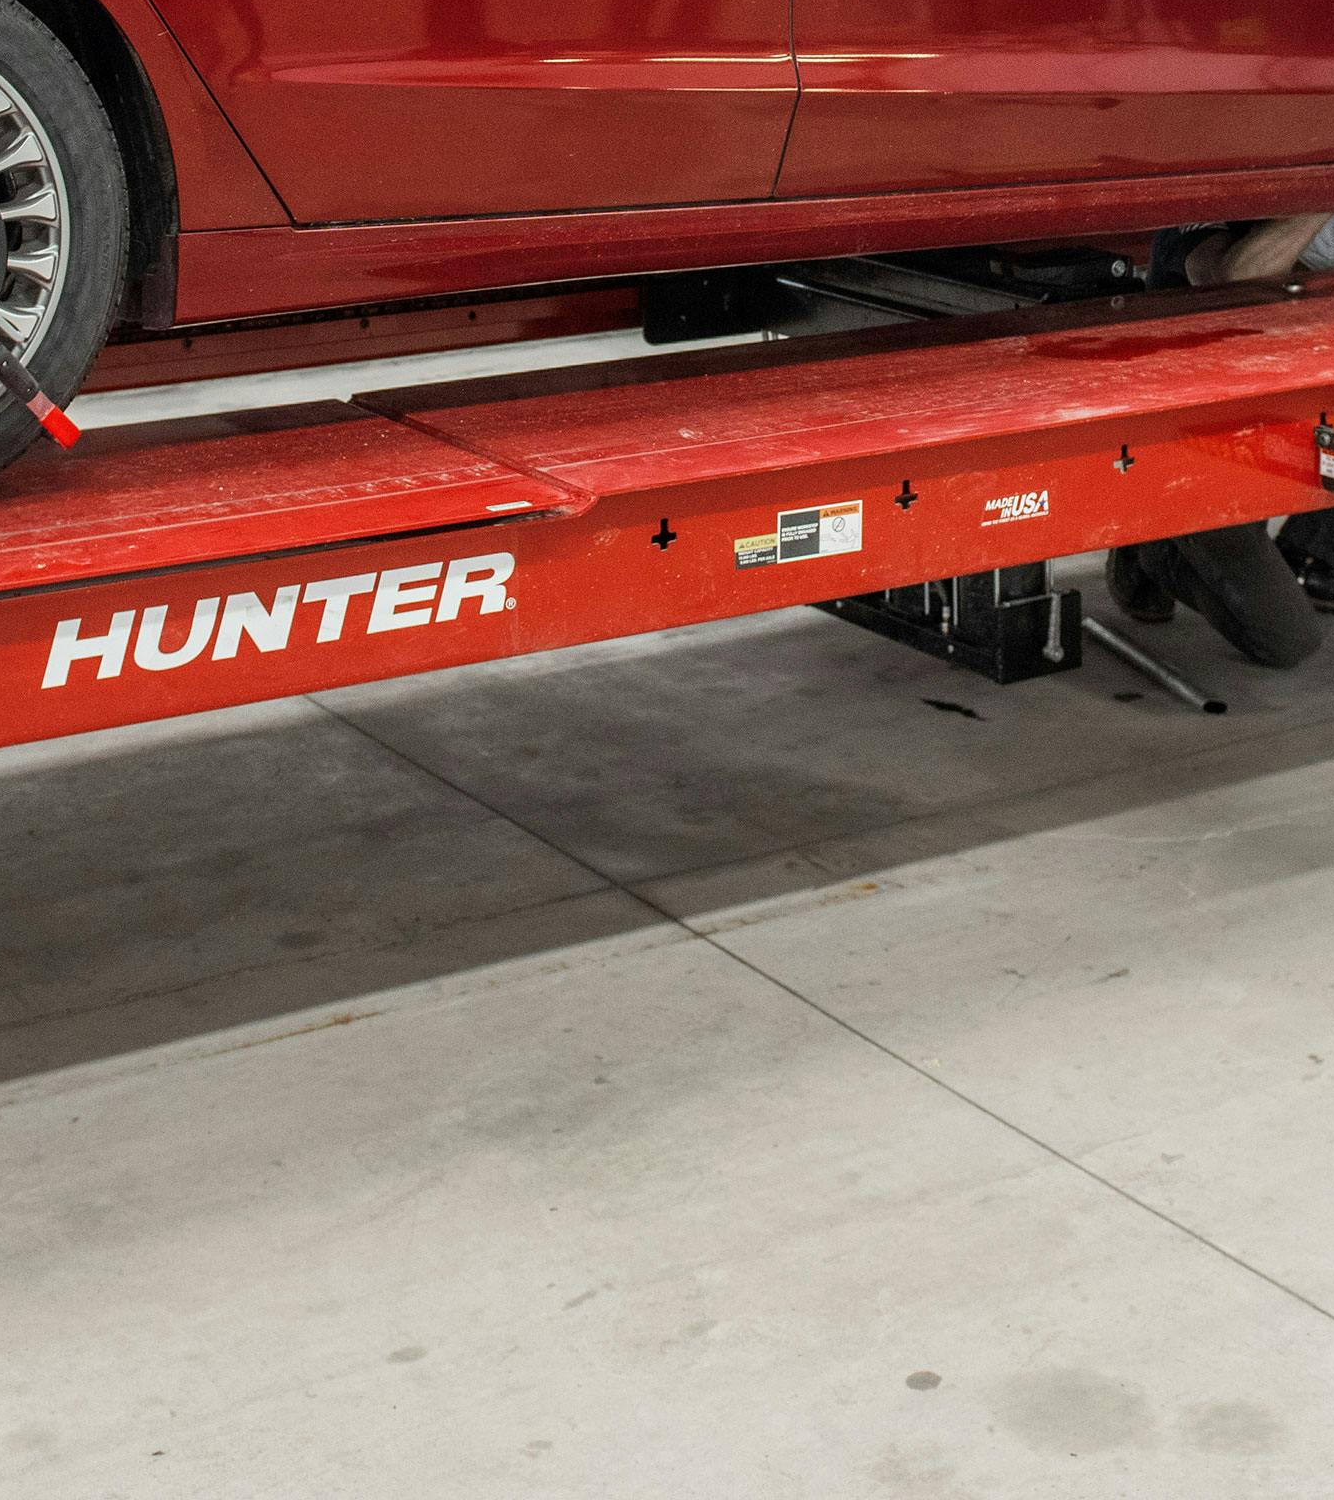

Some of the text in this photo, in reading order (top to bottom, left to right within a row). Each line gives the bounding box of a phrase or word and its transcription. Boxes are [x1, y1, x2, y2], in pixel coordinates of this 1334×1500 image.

[985, 496, 1014, 511] MADE
[1012, 490, 1049, 517] USA
[1000, 507, 1012, 518] IN
[745, 538, 776, 548] CAUTION
[41, 551, 516, 689] HUNTER
